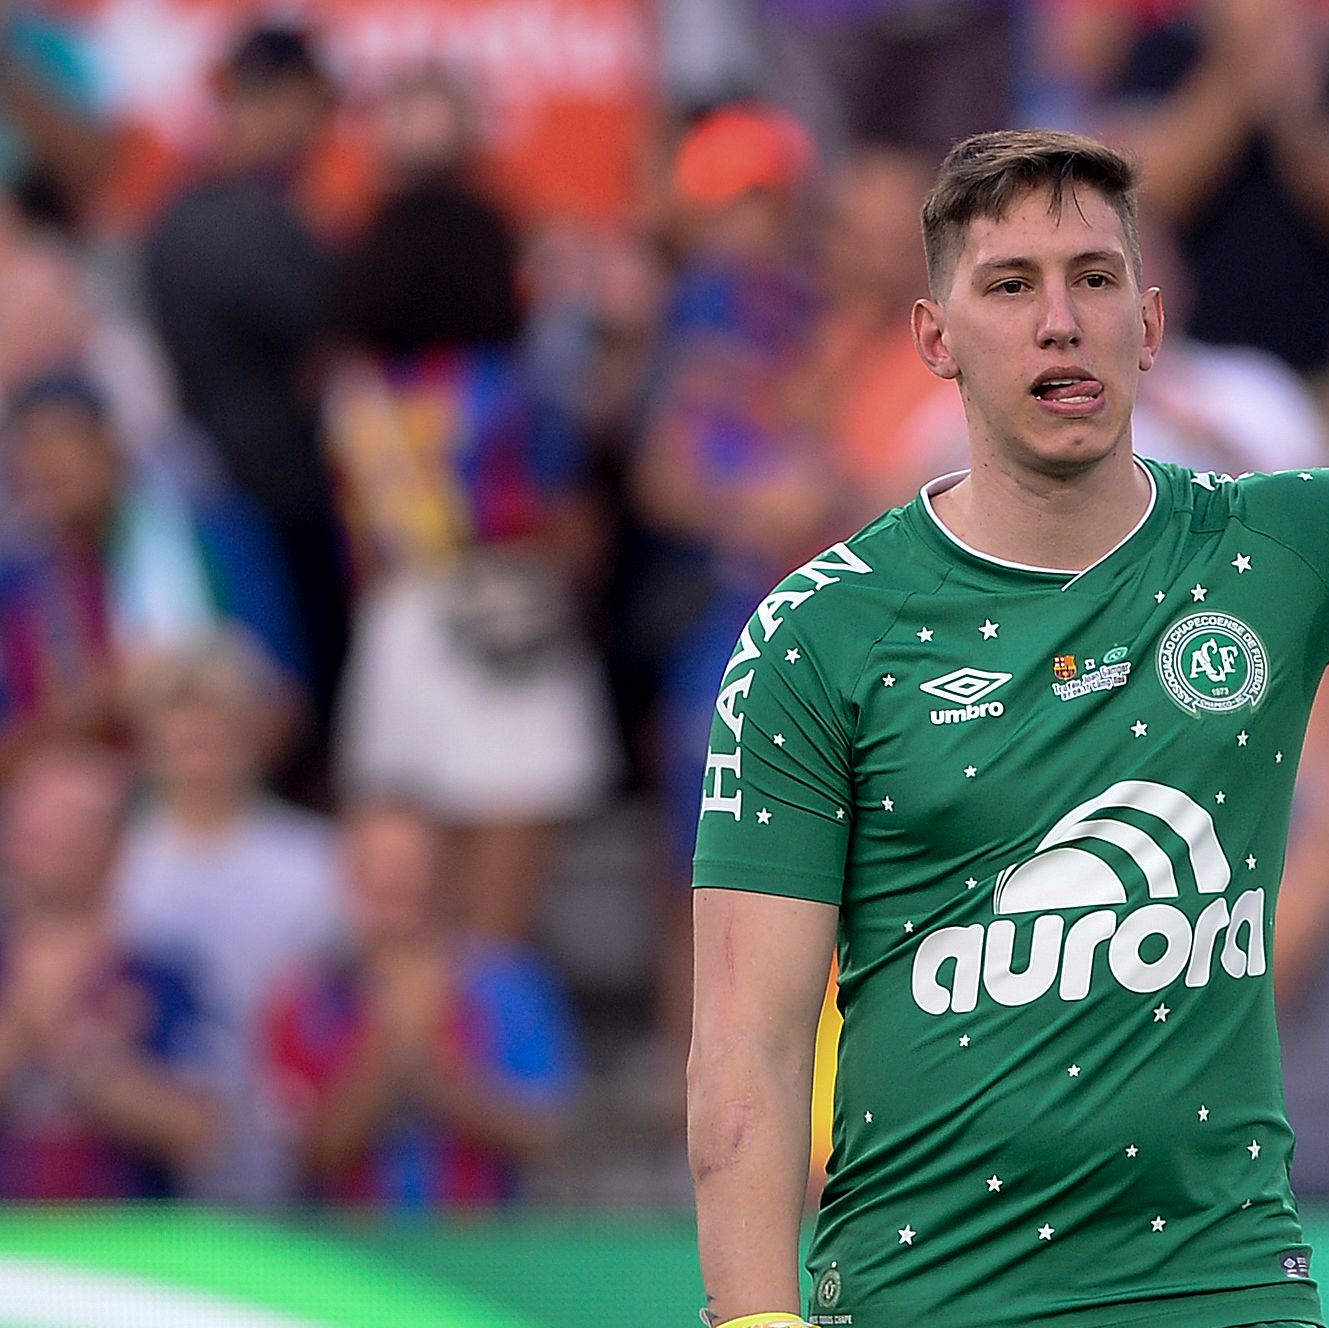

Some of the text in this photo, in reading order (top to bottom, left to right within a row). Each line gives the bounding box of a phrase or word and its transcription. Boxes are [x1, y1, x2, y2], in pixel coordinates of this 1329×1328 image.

[1170, 616, 1245, 642] CHAPECOENSE
[700, 541, 874, 822] HAVAN
[929, 700, 1005, 725] umbro
[912, 888, 1266, 1015] aurora
